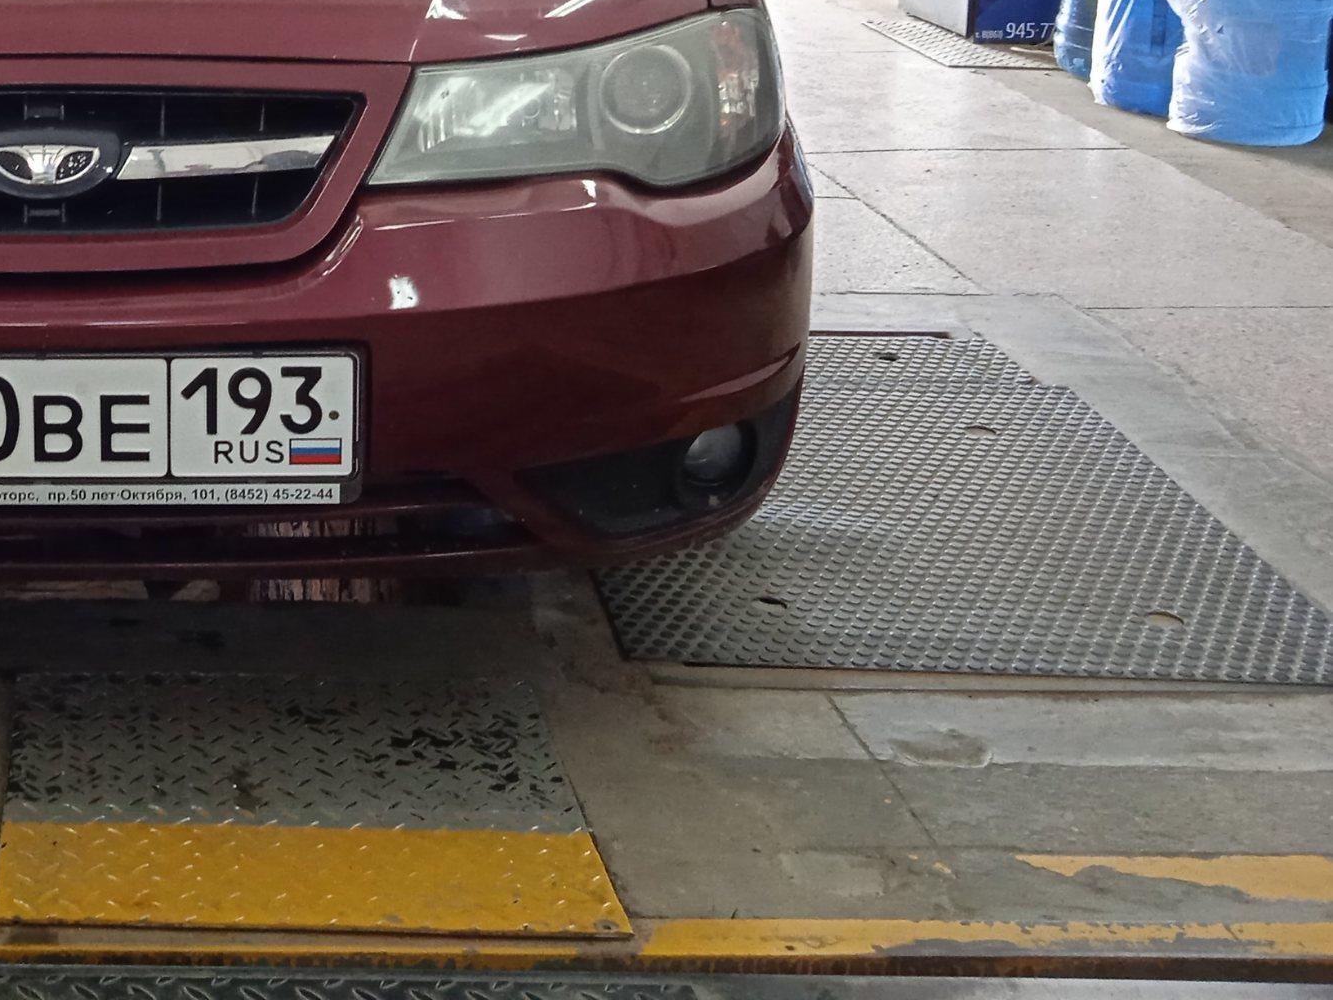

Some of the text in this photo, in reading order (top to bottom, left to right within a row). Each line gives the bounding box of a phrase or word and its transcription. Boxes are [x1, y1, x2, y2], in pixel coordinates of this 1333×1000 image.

[181, 366, 322, 435] 193
[214, 440, 284, 464] RUS
[48, 490, 87, 502] пр.50
[192, 489, 220, 502] 101,
[224, 488, 268, 502] (8452)
[273, 488, 334, 500] 45-22-44
